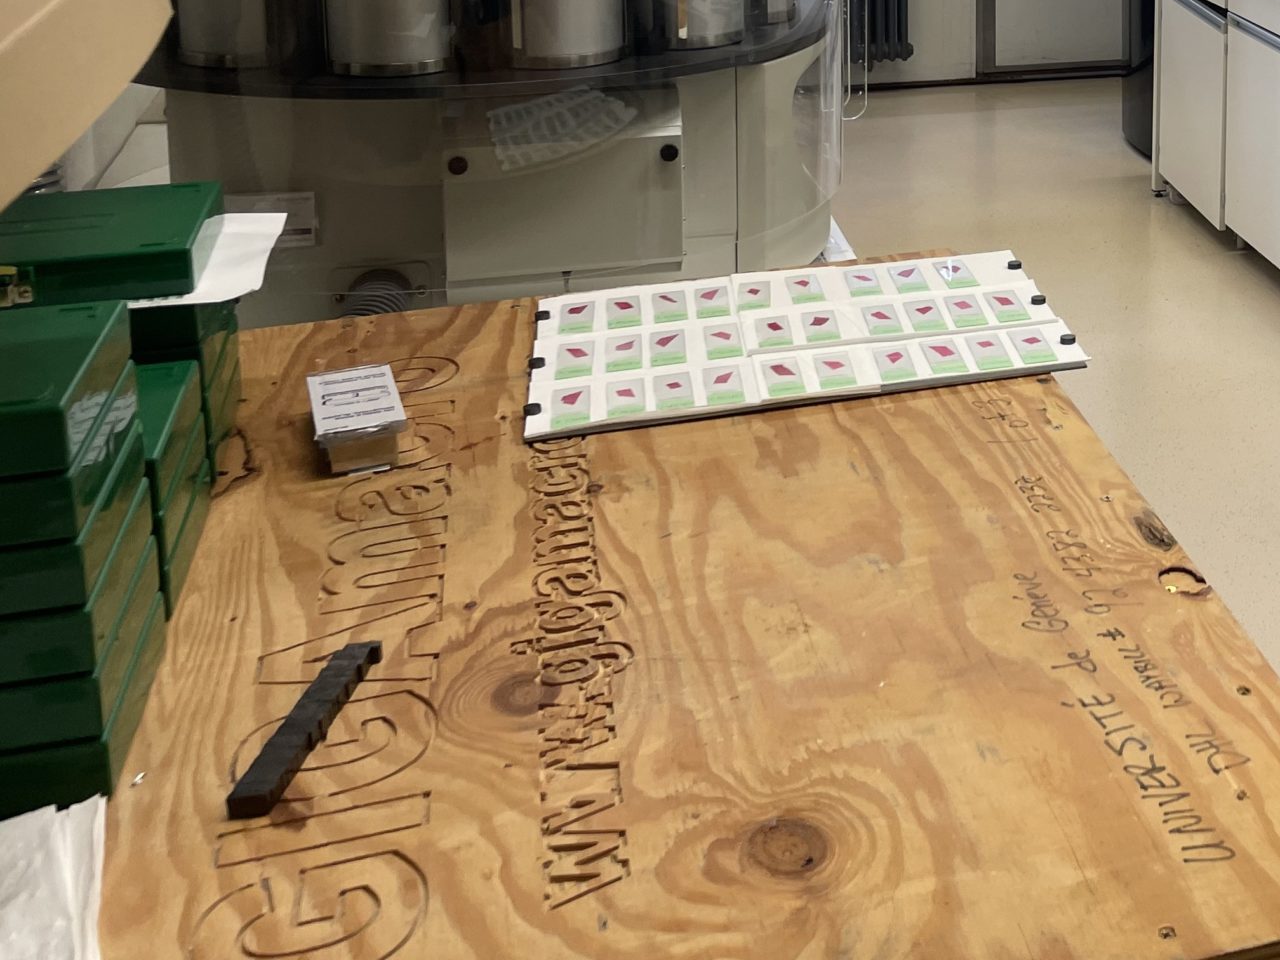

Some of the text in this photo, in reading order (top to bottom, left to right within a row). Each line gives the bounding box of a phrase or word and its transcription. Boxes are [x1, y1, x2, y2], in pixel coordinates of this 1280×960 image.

[1051, 648, 1098, 674] de
[1117, 642, 1193, 711] WAYBILL
[1184, 724, 1252, 776] DHL
